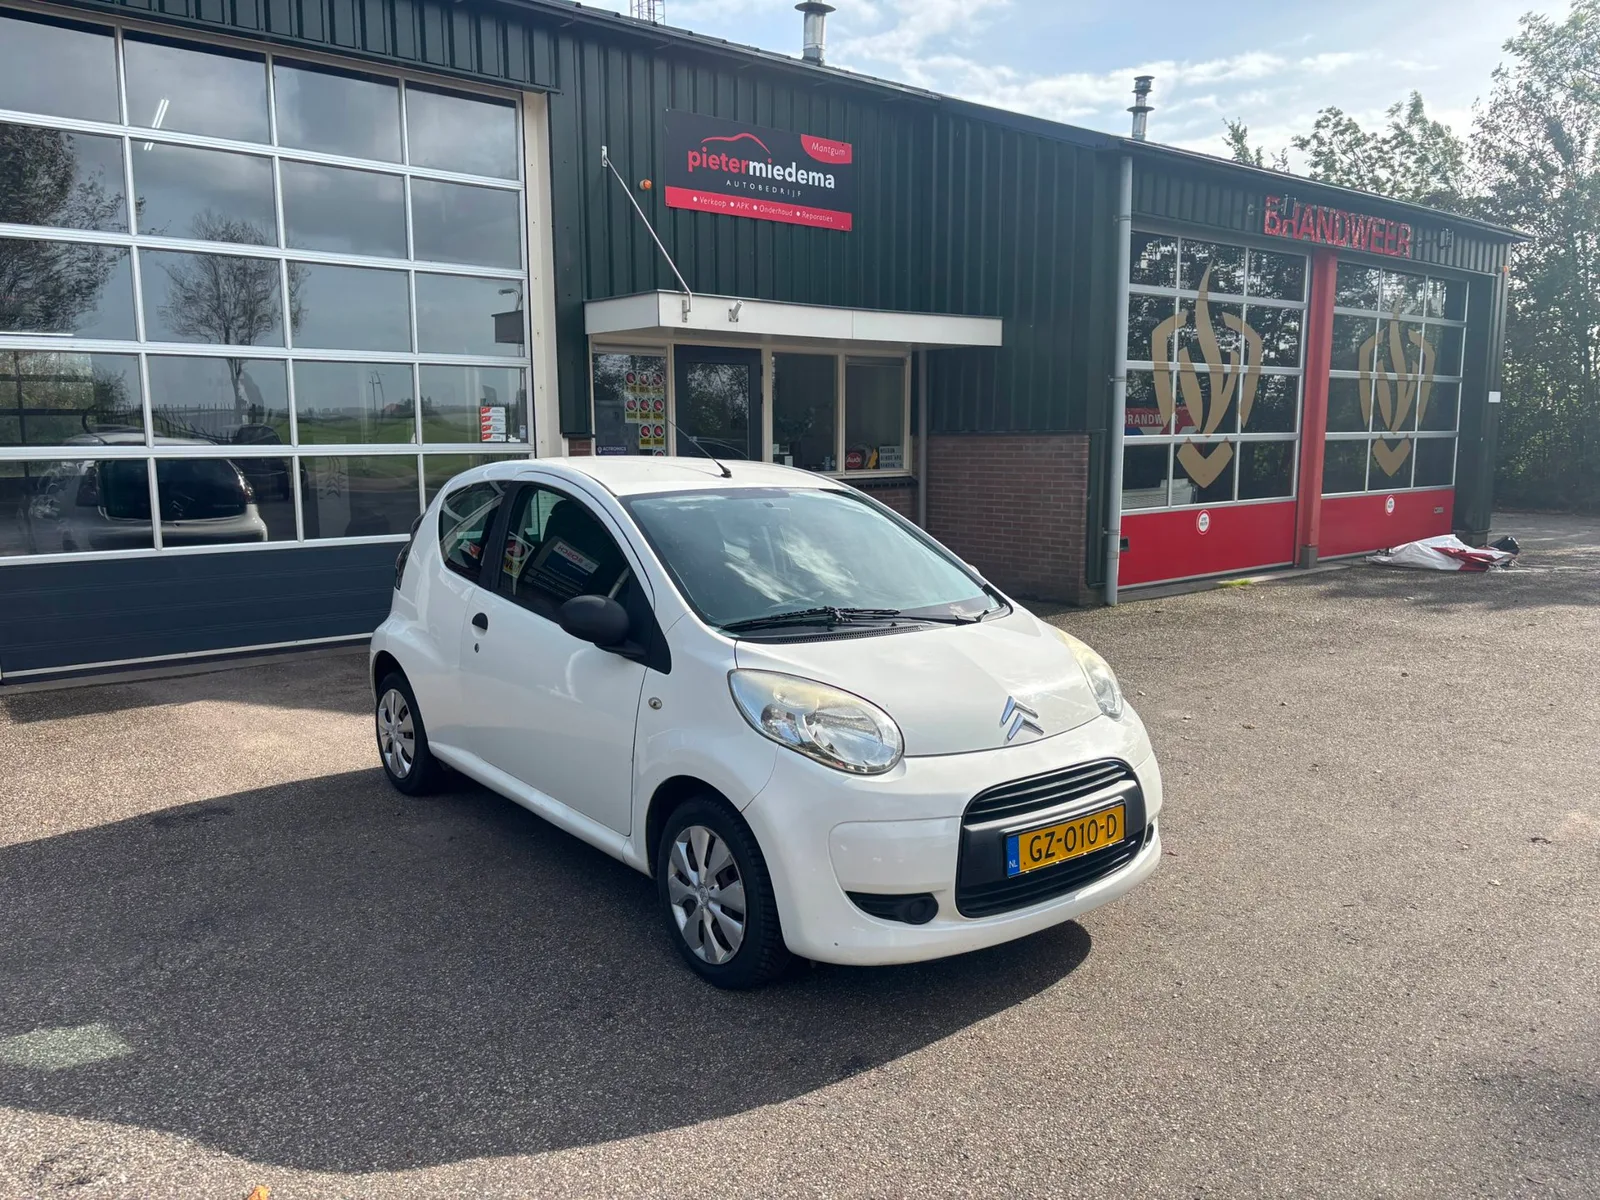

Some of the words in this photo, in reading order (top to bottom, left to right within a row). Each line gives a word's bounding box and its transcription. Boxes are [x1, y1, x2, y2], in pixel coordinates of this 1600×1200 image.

[811, 142, 846, 157] Mantgum
[726, 179, 802, 197] AUTOBEDRIJF
[699, 196, 727, 208] Verkoop
[736, 199, 750, 210] APK
[759, 204, 793, 217] Onderhoud
[802, 210, 833, 223] Reparaties
[1124, 413, 1179, 425] RANDWR
[1029, 813, 1117, 862] GZ-010-D
[1008, 860, 1018, 868] NL
